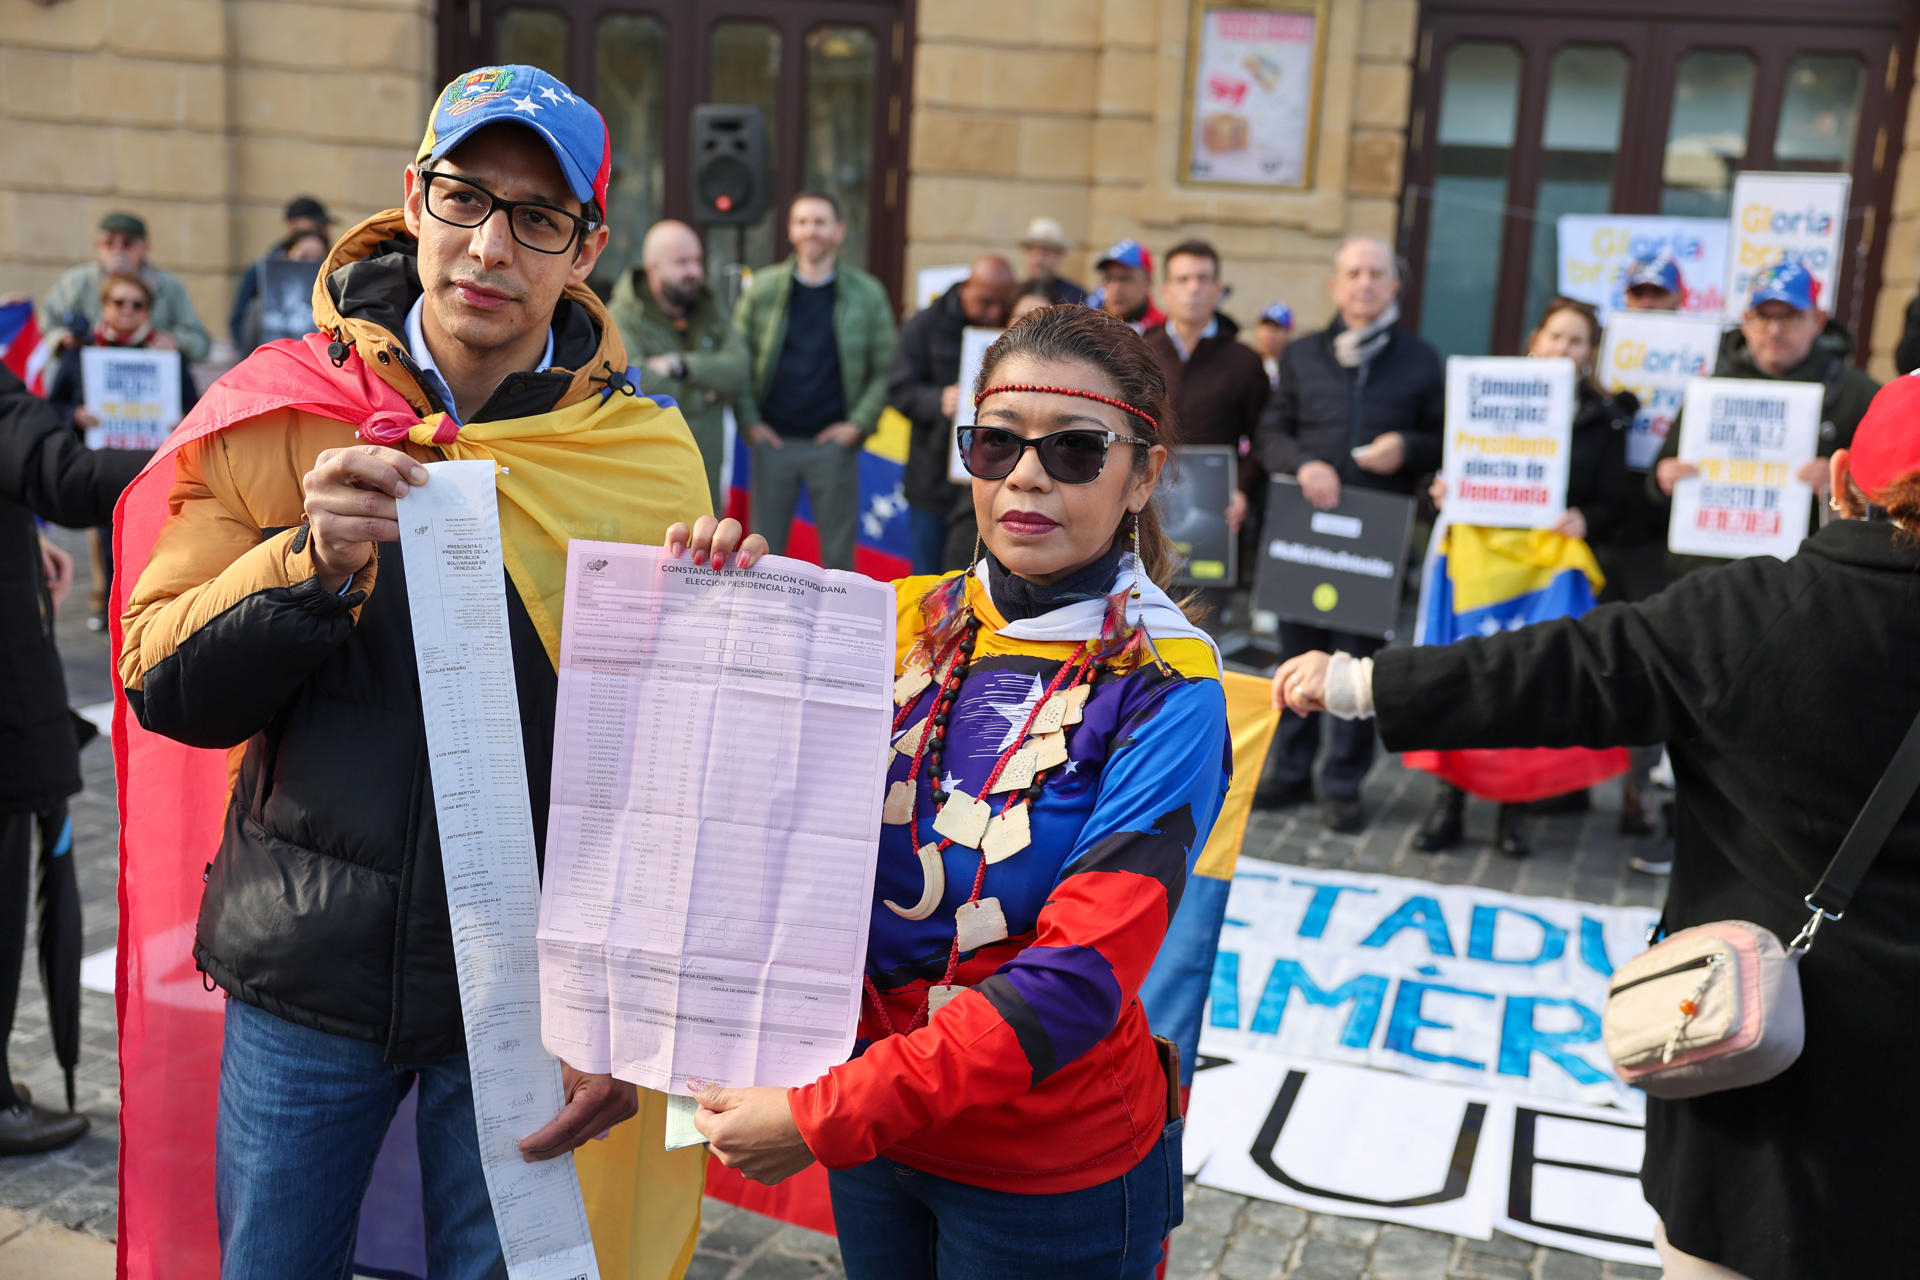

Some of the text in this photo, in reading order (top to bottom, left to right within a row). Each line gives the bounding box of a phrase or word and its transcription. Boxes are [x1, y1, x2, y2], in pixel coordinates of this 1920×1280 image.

[1740, 203, 1833, 236] Gloria
[1592, 226, 1704, 262] Gloria
[1613, 338, 1709, 377] Gloria
[1469, 373, 1553, 398] Edmundo
[1455, 429, 1560, 457] Presidente
[1464, 456, 1546, 479] electo de
[1458, 478, 1551, 504] Venezuela
[661, 565, 721, 577] CONSTANCIA
[798, 578, 847, 594] CIUDADANA
[727, 580, 786, 593] PRESIDENCIAL
[788, 586, 805, 596] 2024
